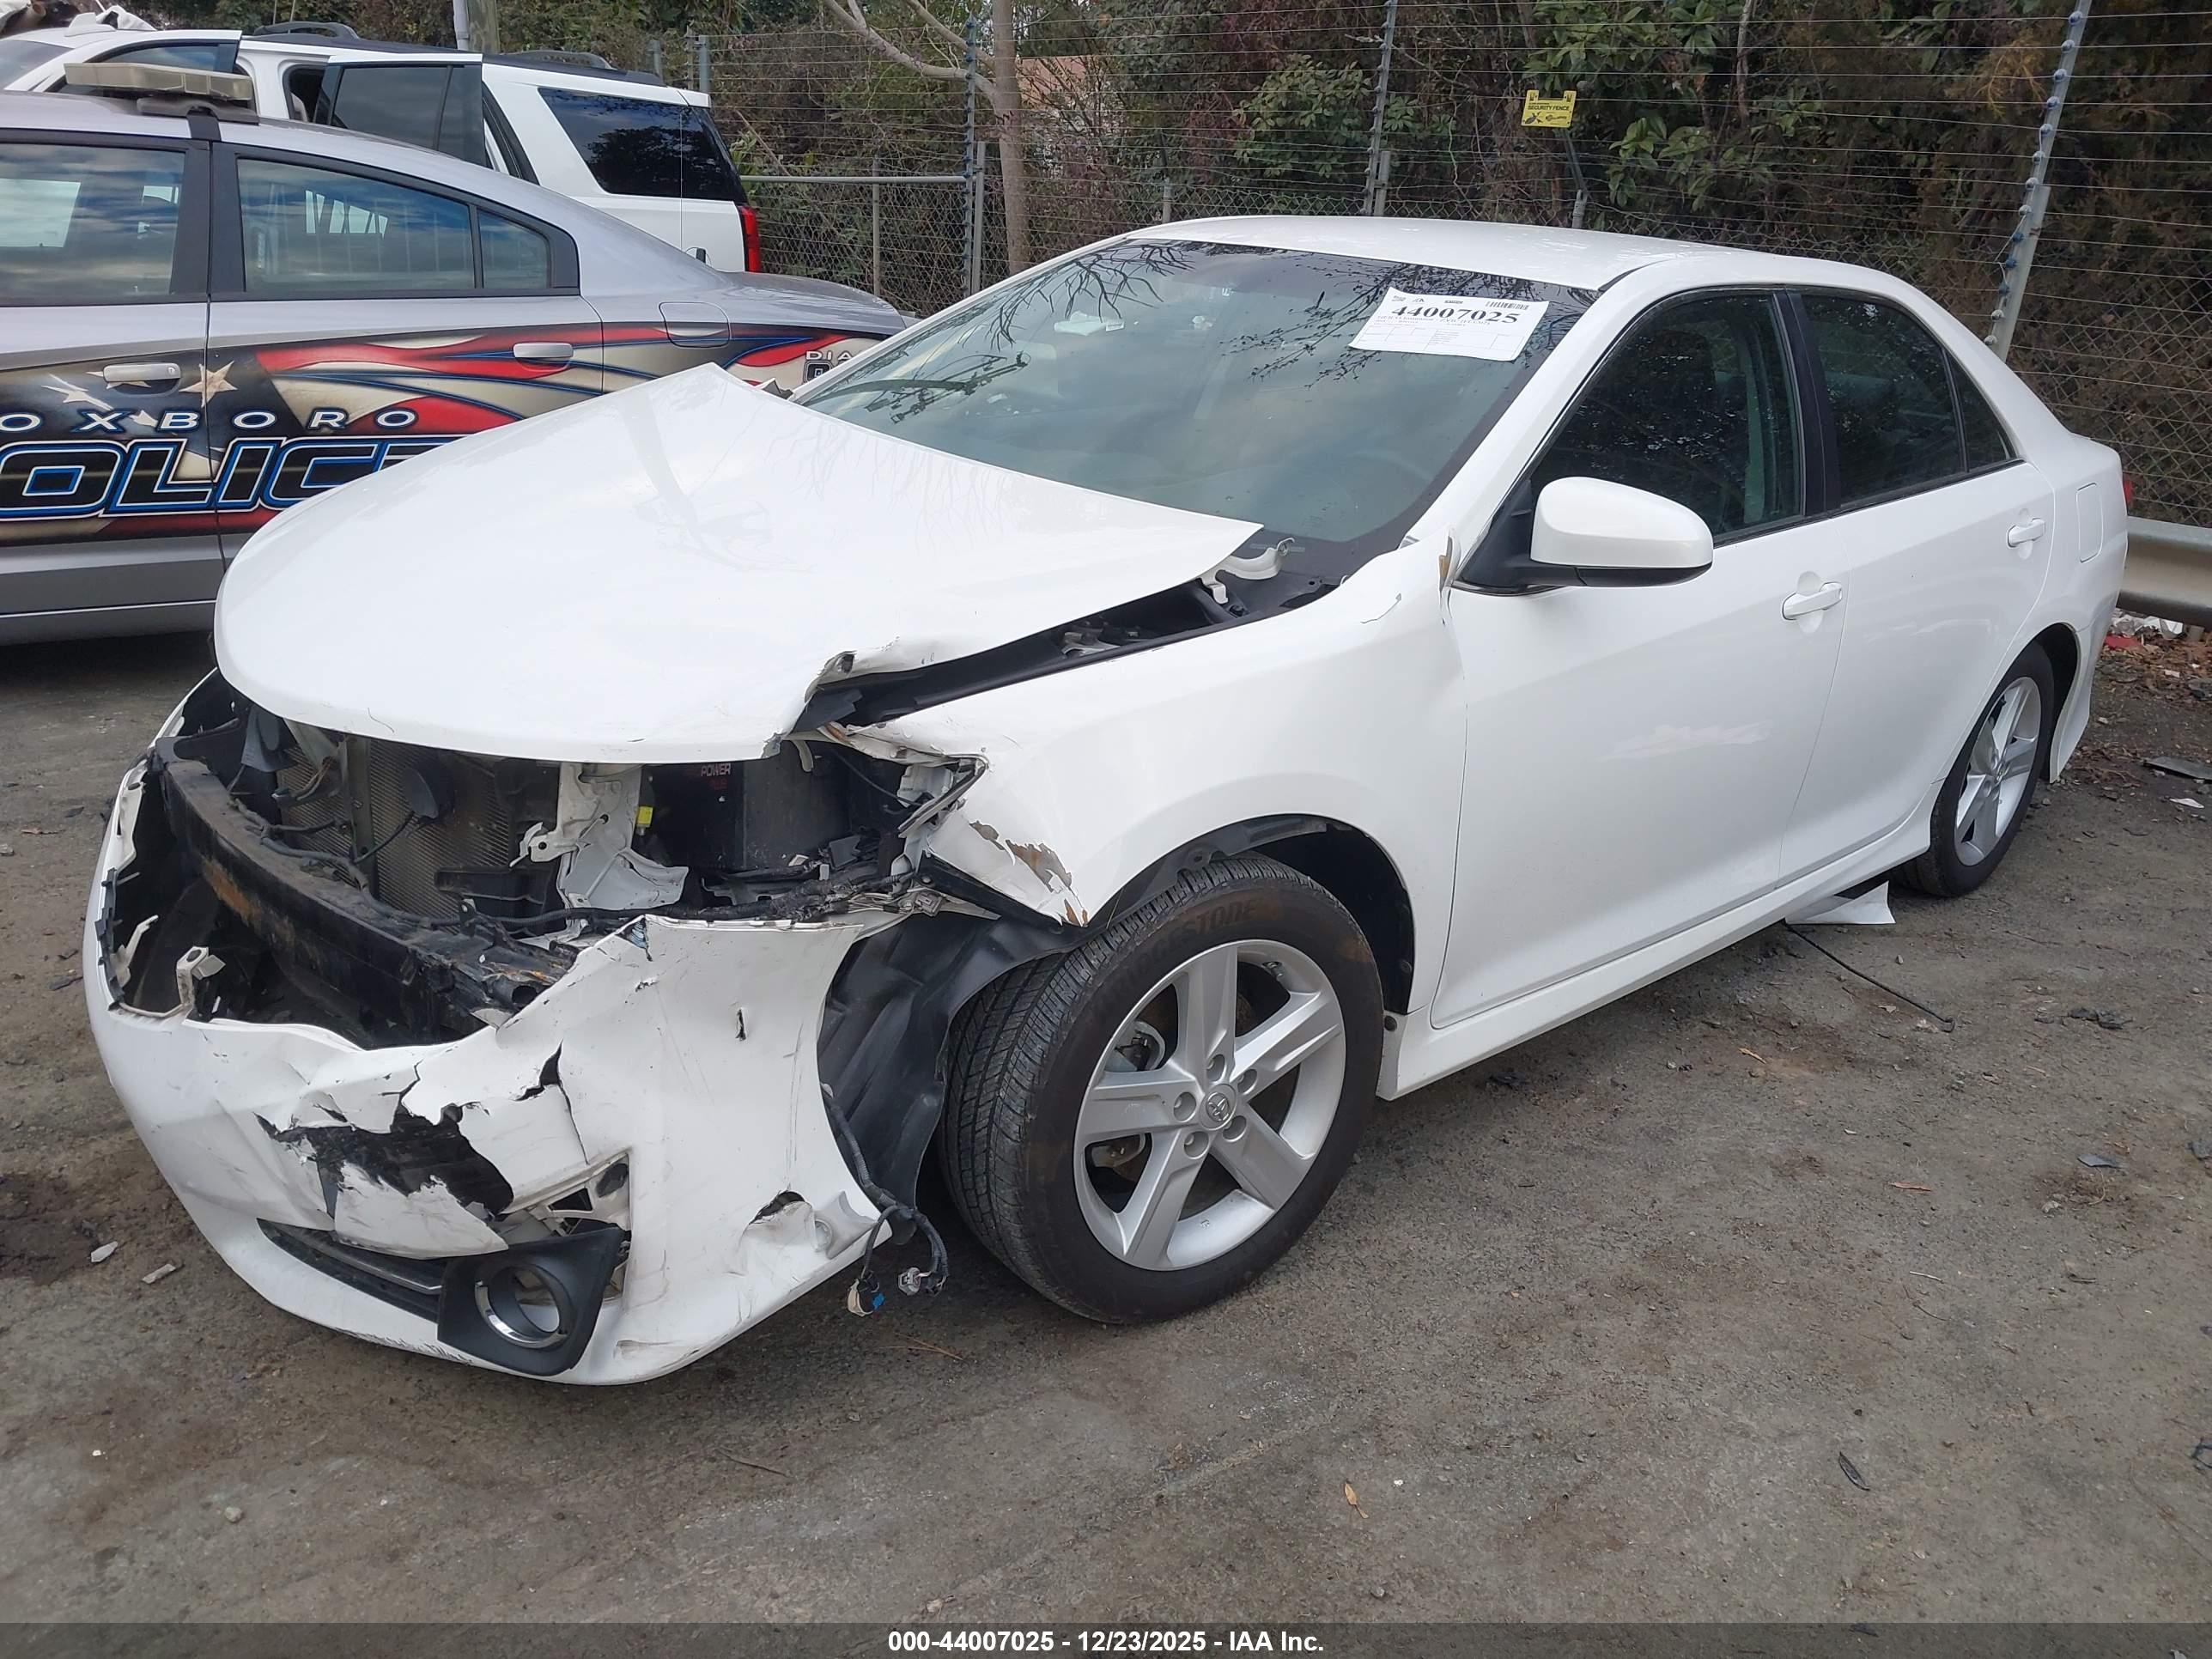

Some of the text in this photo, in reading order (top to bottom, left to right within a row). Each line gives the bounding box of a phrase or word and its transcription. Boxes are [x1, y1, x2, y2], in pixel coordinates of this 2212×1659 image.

[1392, 306, 1521, 324] 44007025
[805, 350, 854, 361] DIA
[0, 410, 418, 431] OXBORO
[0, 434, 477, 521] OLIC
[701, 763, 731, 776] POWER
